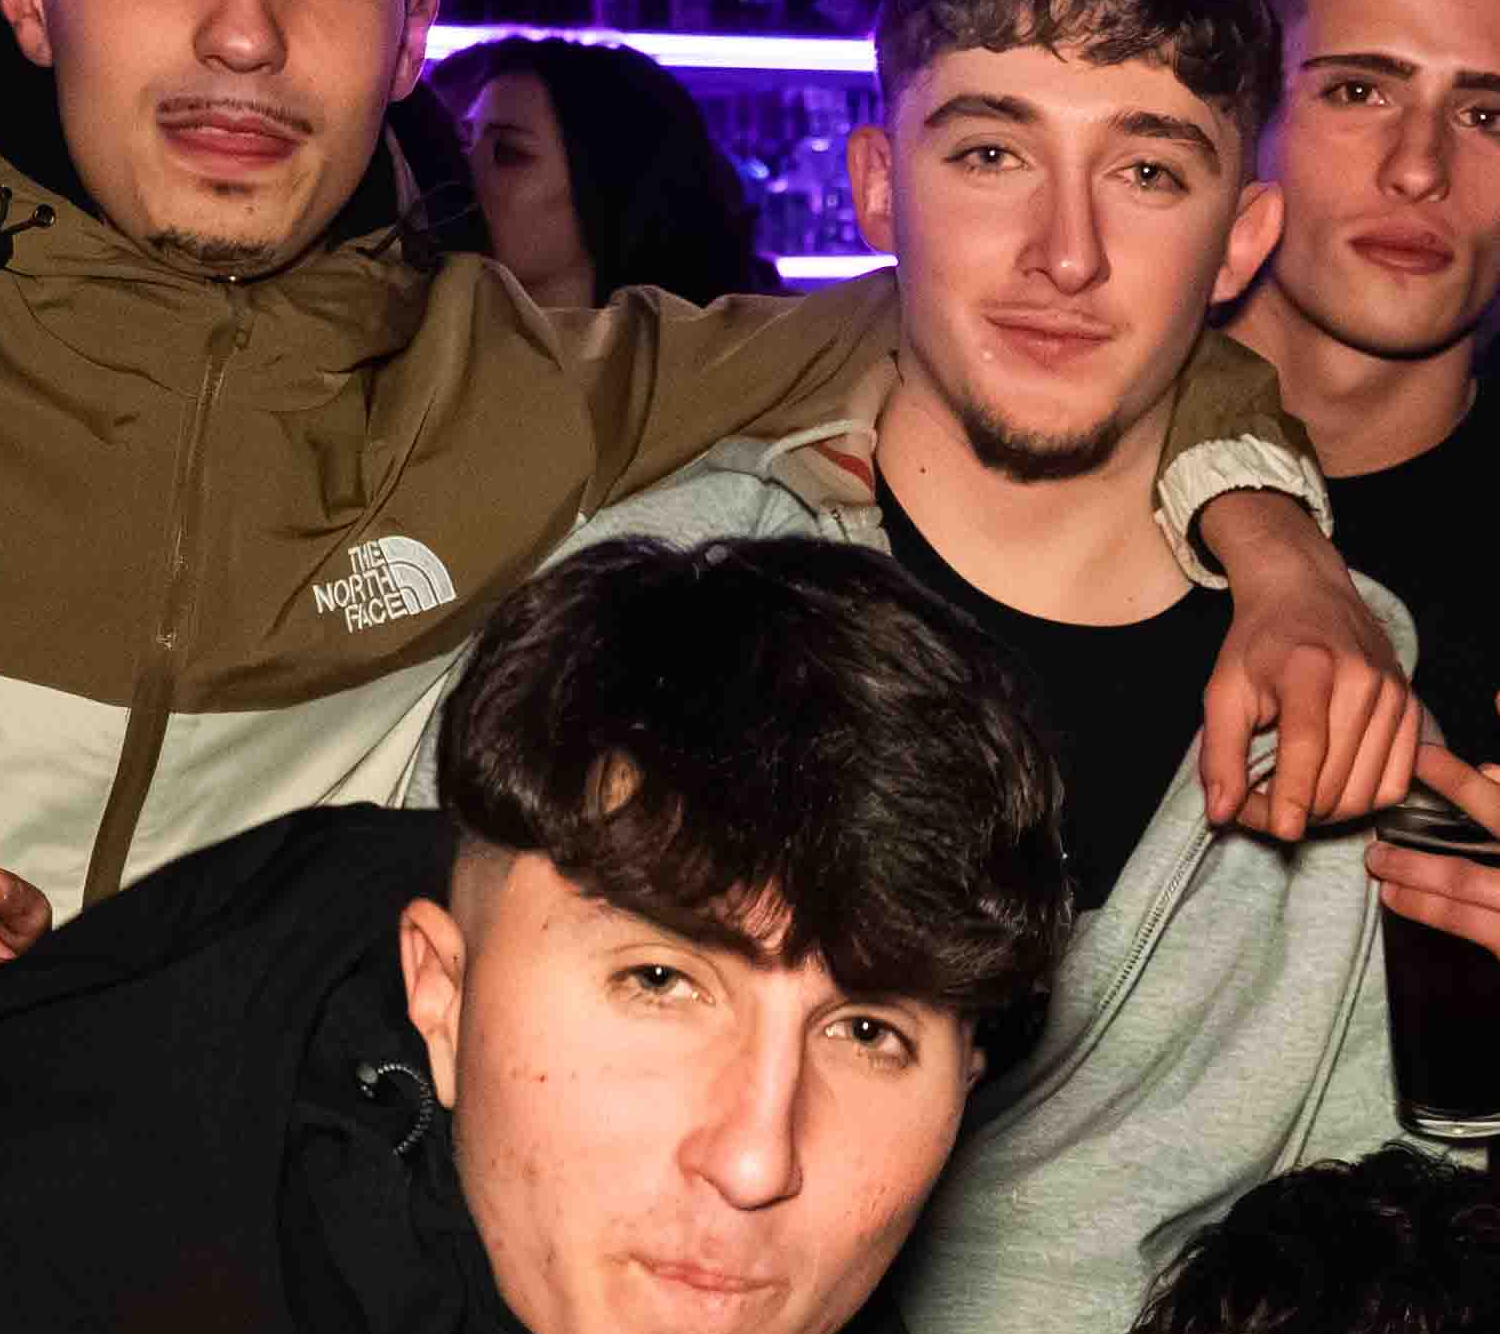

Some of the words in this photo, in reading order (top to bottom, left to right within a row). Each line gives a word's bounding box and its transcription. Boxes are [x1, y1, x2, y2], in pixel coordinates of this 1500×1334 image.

[347, 540, 387, 574] THE
[311, 564, 398, 615] NORTH
[344, 593, 408, 633] FACE
